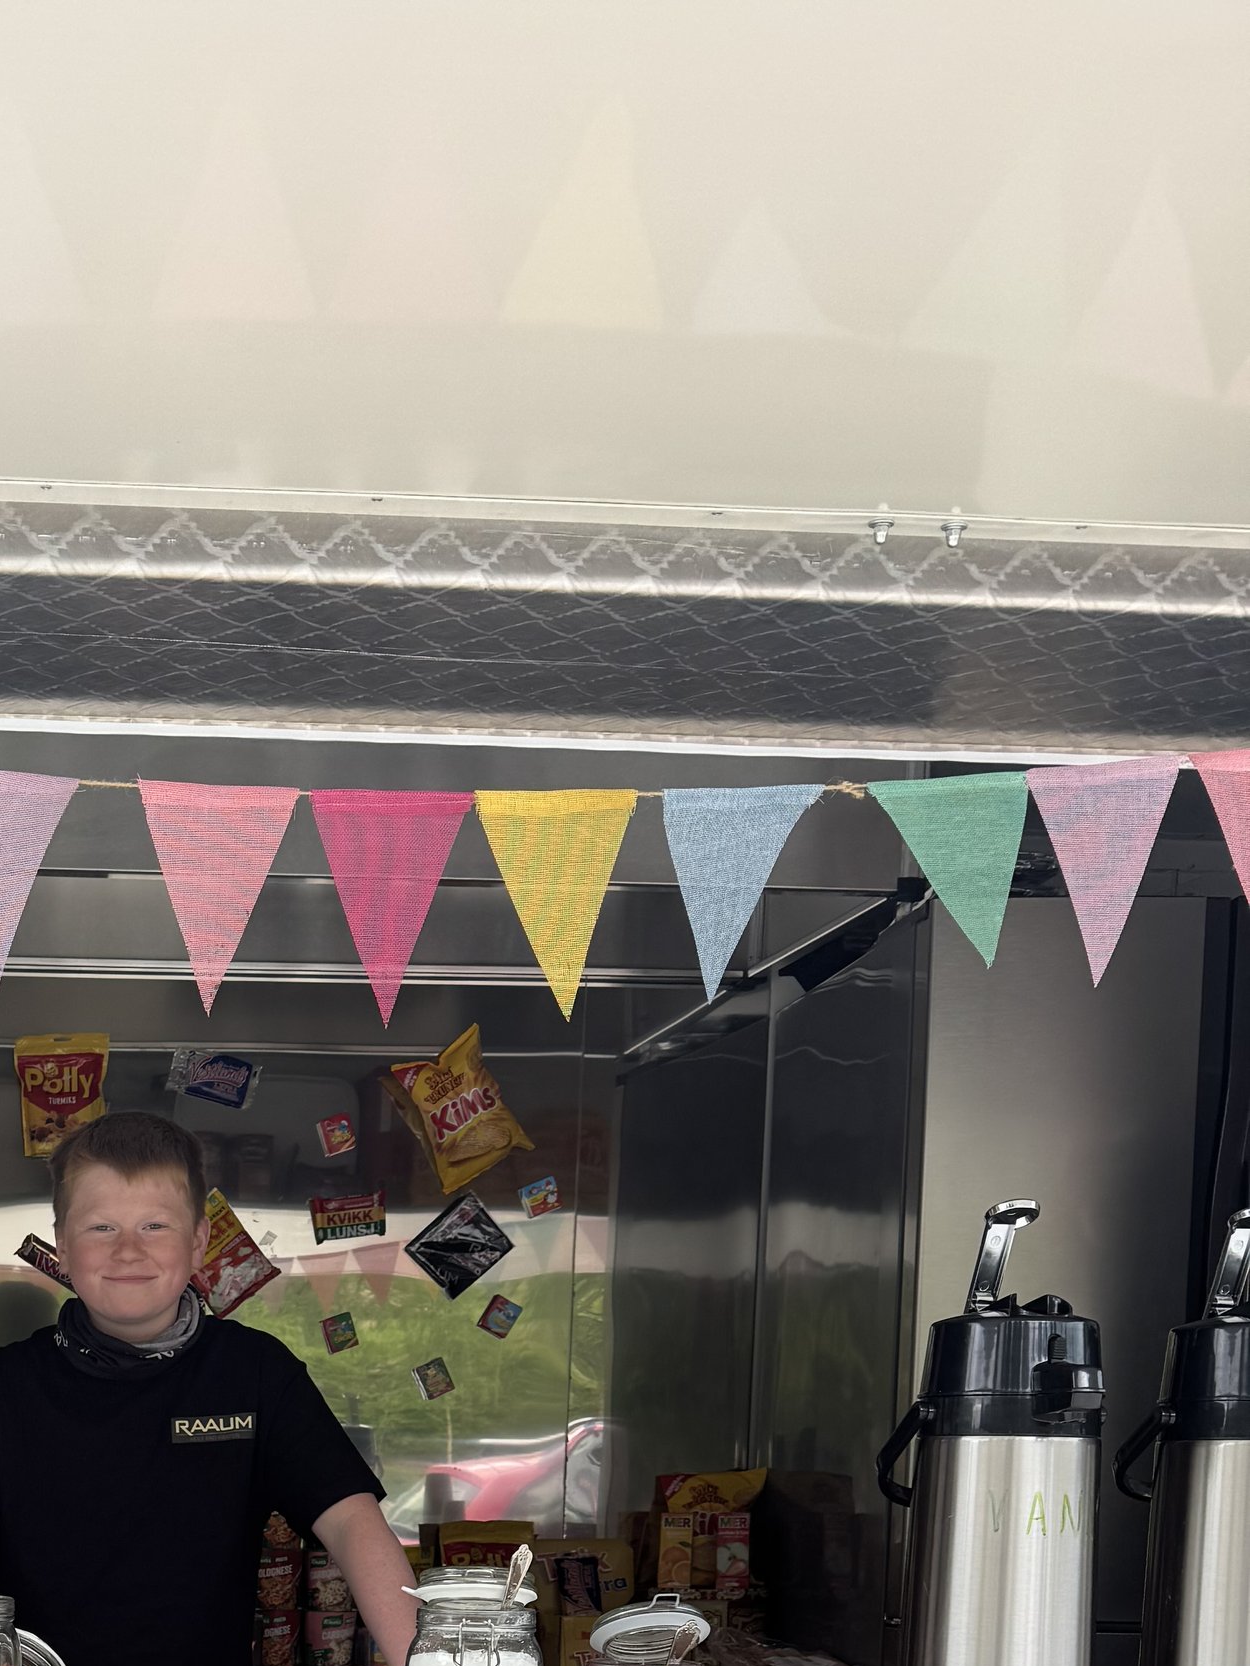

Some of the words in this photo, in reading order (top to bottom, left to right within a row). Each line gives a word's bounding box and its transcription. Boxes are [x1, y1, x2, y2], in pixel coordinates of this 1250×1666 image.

[24, 1066, 94, 1098] Polly
[327, 1209, 373, 1227] KVIKK
[175, 1416, 253, 1437] RAAUM
[664, 1517, 692, 1529] MER
[720, 1517, 748, 1529] MER
[258, 1564, 293, 1578] OLOGNESE
